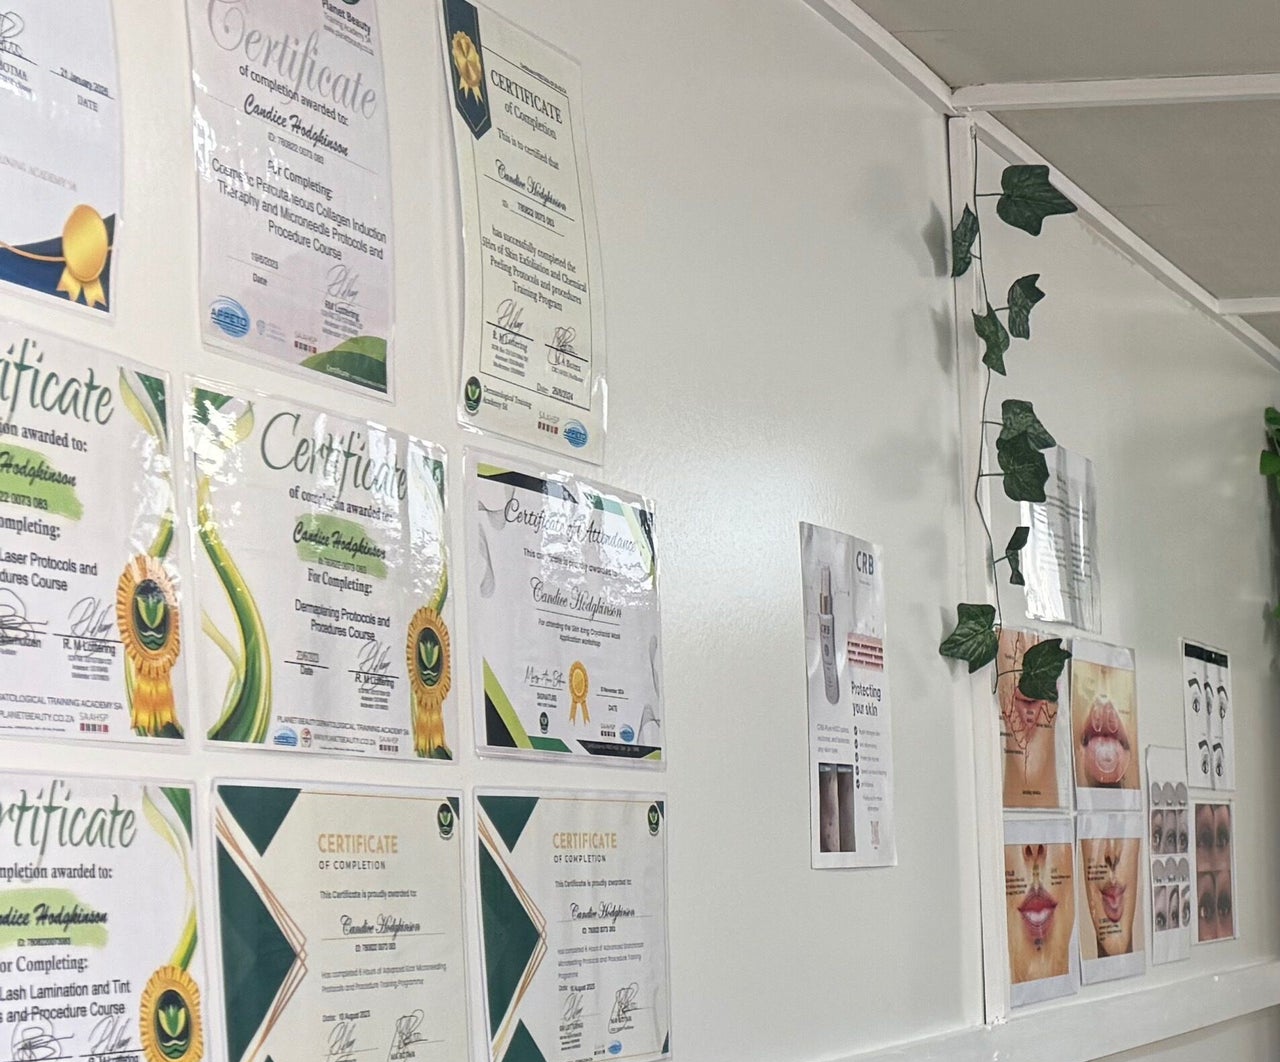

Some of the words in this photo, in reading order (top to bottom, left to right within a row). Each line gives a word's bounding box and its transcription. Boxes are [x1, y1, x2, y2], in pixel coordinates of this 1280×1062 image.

[207, 0, 377, 119] Certificate
[77, 94, 99, 112] DATE
[239, 65, 248, 77] of
[250, 72, 299, 101] completion
[301, 95, 337, 120] awarded
[490, 69, 562, 124] CERTIFICATE
[244, 94, 287, 128] Candice
[289, 114, 349, 156] Hodgkinson
[505, 103, 513, 116] of
[514, 106, 557, 140] Completion
[495, 159, 526, 190] Candice
[262, 201, 278, 216] and
[280, 206, 330, 238] Microneedle
[332, 227, 368, 252] Protocols
[369, 245, 383, 260] and
[316, 202, 351, 227] Collagen
[352, 217, 387, 244] Induction
[268, 219, 311, 248] Procedure
[313, 238, 342, 260] Course
[537, 248, 567, 269] completed
[561, 273, 587, 293] Chemical
[21, 425, 69, 449] awarded
[71, 437, 88, 453] to:
[261, 411, 407, 502] Certificate
[0, 451, 77, 487] Hodgkinson
[289, 485, 300, 500] of
[504, 497, 565, 533] Certificate
[293, 521, 329, 545] Candice
[30, 552, 77, 575] Protocols
[79, 562, 98, 577] and
[856, 551, 875, 576] CRB
[31, 572, 68, 592] Course
[308, 568, 321, 583] For
[322, 571, 372, 597] Completing:
[530, 576, 568, 606] Candice
[341, 608, 376, 626] Protocols
[377, 616, 391, 628] and
[349, 626, 376, 642] Course
[851, 681, 881, 702] Protecting
[853, 702, 864, 717] your
[866, 703, 878, 717] skin
[318, 833, 398, 853] CERTIFICATE
[553, 832, 617, 848] CERTIFICATE
[318, 860, 330, 870] OF
[333, 860, 386, 870] COMPLETION
[554, 855, 562, 863] OF
[565, 854, 606, 863] COMPLETION
[51, 864, 95, 879] awarded
[98, 866, 113, 879] to:
[33, 902, 108, 932] Hodgkinson
[16, 955, 88, 975] Completing:
[30, 982, 91, 1000] Lamination
[92, 982, 110, 996] and
[112, 979, 131, 994] Tint
[6, 1007, 28, 1023] and
[31, 1004, 88, 1021] Procedure
[89, 1002, 125, 1017] Course
